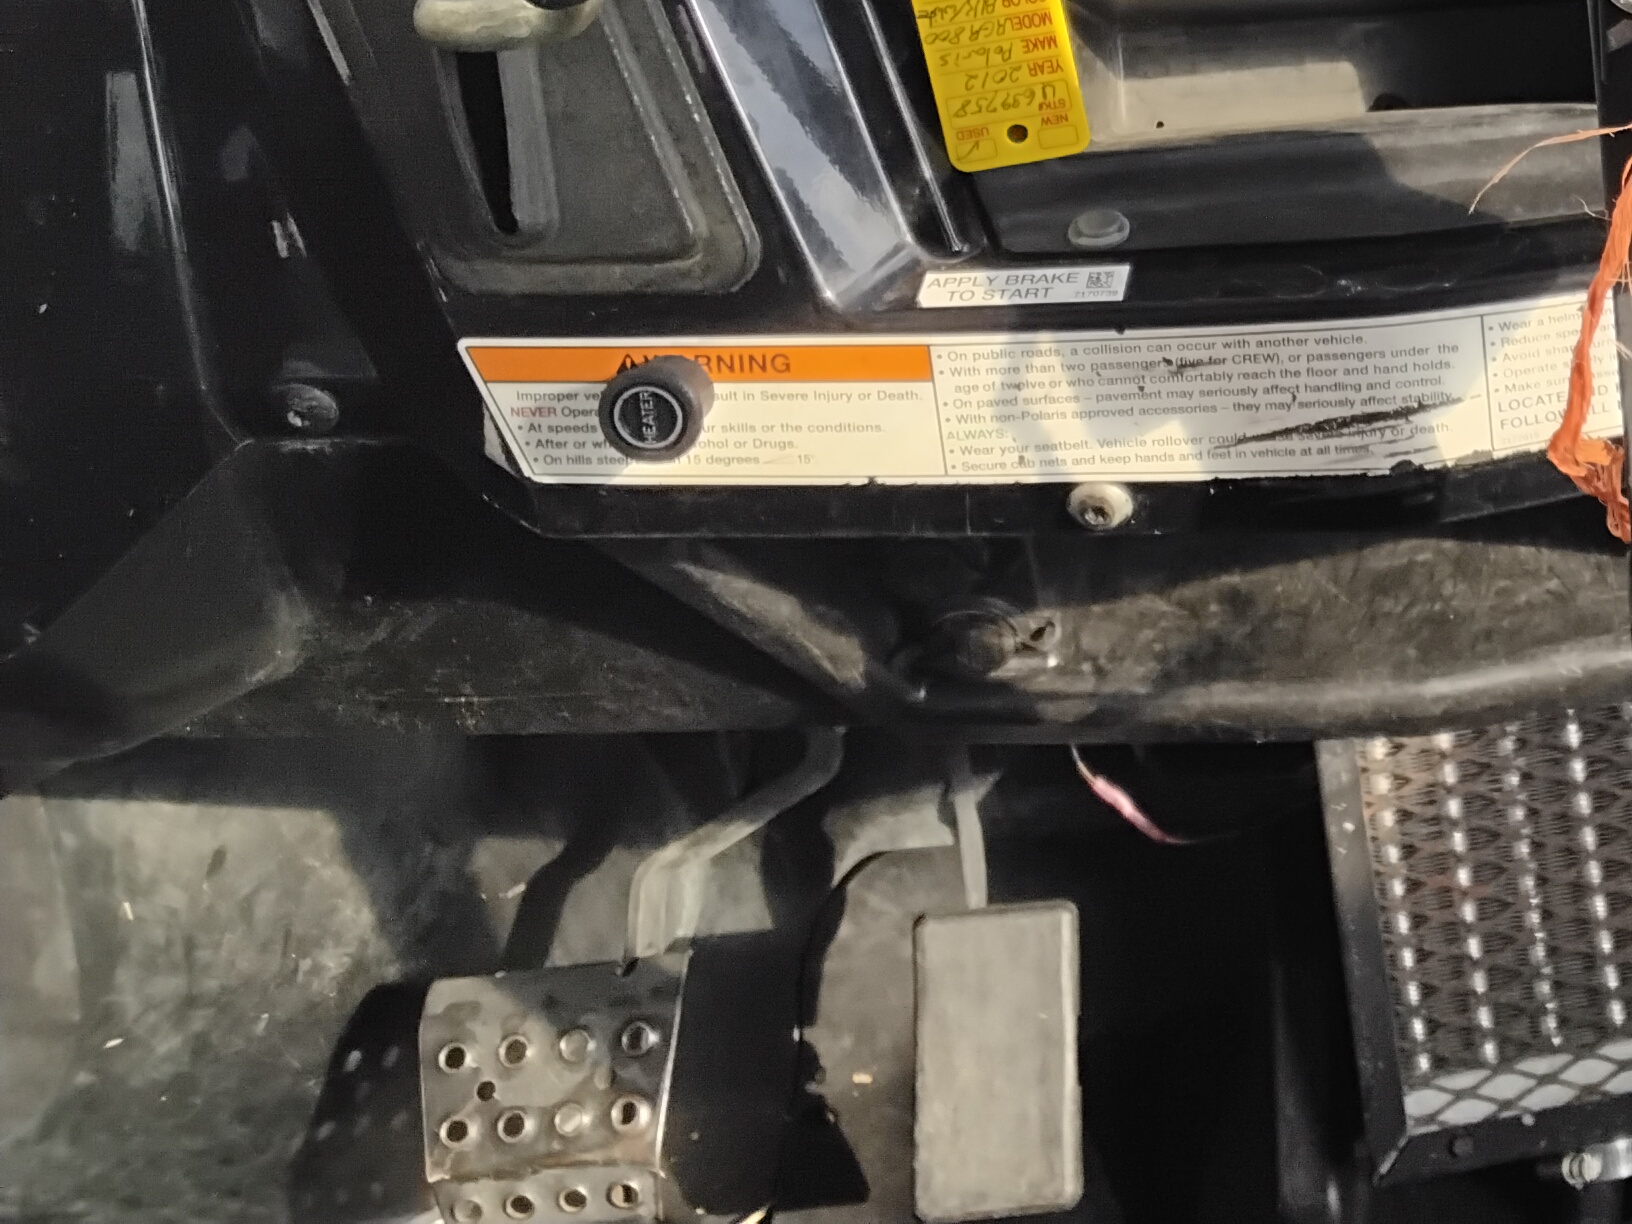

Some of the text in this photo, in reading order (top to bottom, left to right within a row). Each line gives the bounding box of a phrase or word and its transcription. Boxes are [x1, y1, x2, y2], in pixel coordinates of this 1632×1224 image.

[1007, 10, 1053, 32] MODEL
[1020, 35, 1058, 54] MAKE
[965, 58, 1064, 91] YEAR 2012
[1040, 113, 1069, 126] NEW
[956, 127, 989, 141] USED
[927, 272, 1080, 289] APPLY BRAKE
[947, 287, 1055, 302] TO START
[1498, 319, 1545, 332] Wear a
[1500, 333, 1551, 348] Reduce
[947, 351, 968, 362] On
[972, 349, 1016, 363] public
[1020, 347, 1065, 359] roads,
[1070, 348, 1078, 356] a
[1083, 343, 1141, 356] collision
[1146, 344, 1172, 353] can
[1177, 342, 1217, 352] occur
[1222, 338, 1250, 349] with
[1255, 336, 1309, 348] another
[1502, 349, 1540, 362] Avoid
[949, 344, 1459, 377] With more than two for CREW), or passengers under the
[954, 384, 979, 395] age
[982, 381, 996, 391] of
[1000, 380, 1045, 391] twelve
[1049, 380, 1062, 389] or
[1066, 377, 1094, 387] who
[1097, 375, 1146, 387] cannot
[1150, 371, 1234, 384] comfortably
[1237, 369, 1276, 380] reach
[1280, 368, 1301, 379] the
[1306, 365, 1339, 377] floor
[1343, 364, 1369, 376] and
[1373, 362, 1408, 374] hand
[1503, 363, 1559, 379] Operate
[952, 399, 972, 409] On
[976, 396, 1018, 410] paved
[1022, 393, 1080, 405] surfaces
[1096, 389, 1162, 404] pavement
[1166, 390, 1194, 401] may
[1200, 385, 1258, 398] seriously
[1262, 383, 1300, 395] affect
[1304, 381, 1362, 393] handling
[1366, 379, 1390, 390] and
[1505, 380, 1541, 394] Make
[516, 391, 578, 403] Improper
[743, 390, 923, 403] in Severe Injury or Death.
[1498, 391, 1567, 413] LOCATE
[510, 407, 557, 418] NEVER
[955, 395, 1397, 424] With non-Polaris approved accessories they may seriously affect
[640, 391, 658, 445] HEATER
[527, 423, 598, 436] At speeds
[721, 423, 757, 433] skills
[762, 424, 776, 433] or
[781, 422, 802, 433] the
[947, 428, 1009, 441] ALWAYS:
[535, 439, 569, 449] After
[573, 441, 586, 449] or
[734, 439, 798, 451] or Drugs.
[959, 445, 996, 456] Wear
[1000, 445, 1029, 457] your
[1034, 438, 1093, 451] seatbelt.
[1097, 436, 1147, 449] Vehicle
[1152, 434, 1204, 447] rollover
[1391, 426, 1405, 436] or
[543, 455, 593, 465] On hills
[687, 455, 701, 465] 15
[706, 454, 761, 467] degrees
[961, 444, 1330, 472] Secure cab nets and keep hands and feet in vehicle at all
